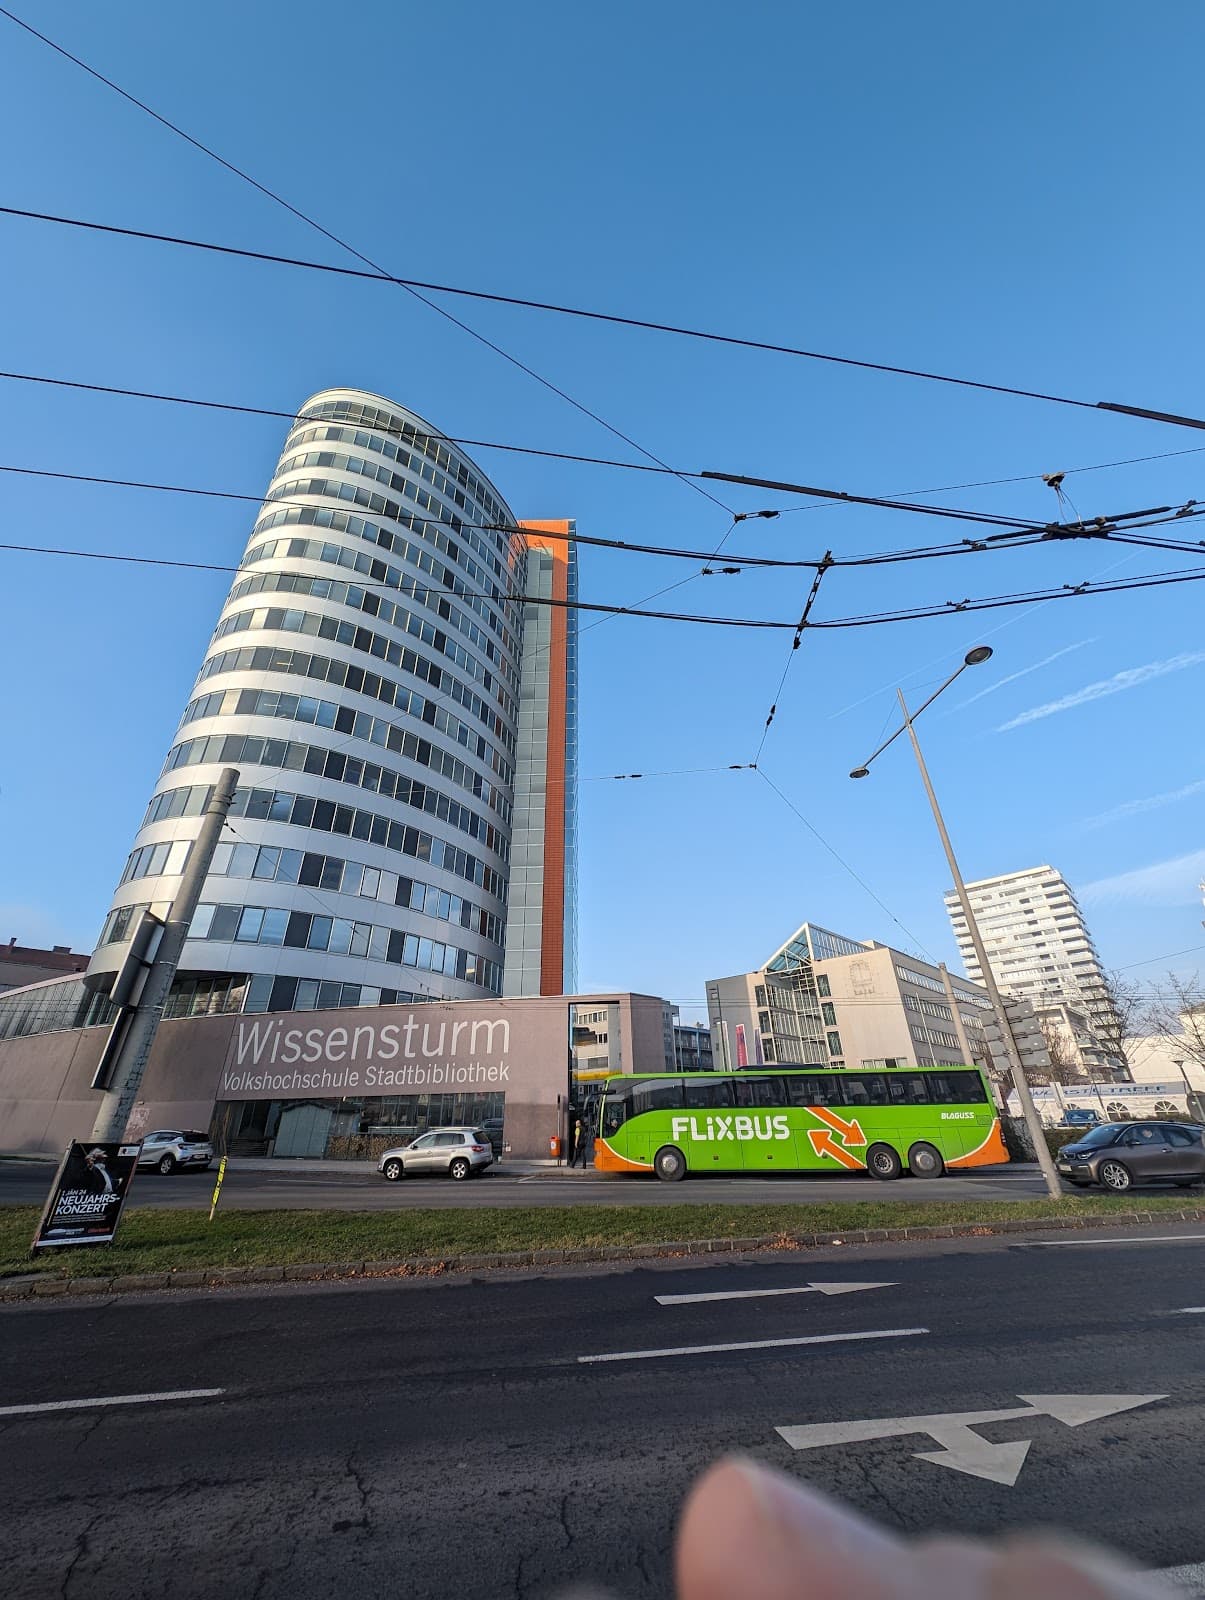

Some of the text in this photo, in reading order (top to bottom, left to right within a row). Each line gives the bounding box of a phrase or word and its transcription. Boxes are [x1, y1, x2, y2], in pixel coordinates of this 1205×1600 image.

[237, 1014, 510, 1064] Wissensturm
[223, 1061, 510, 1091] Volkshochschule Stadtbibliothek
[941, 1112, 975, 1120] BLAGUSS
[59, 1194, 120, 1205] NEUJAHRS-
[56, 1203, 108, 1215] KONZERT
